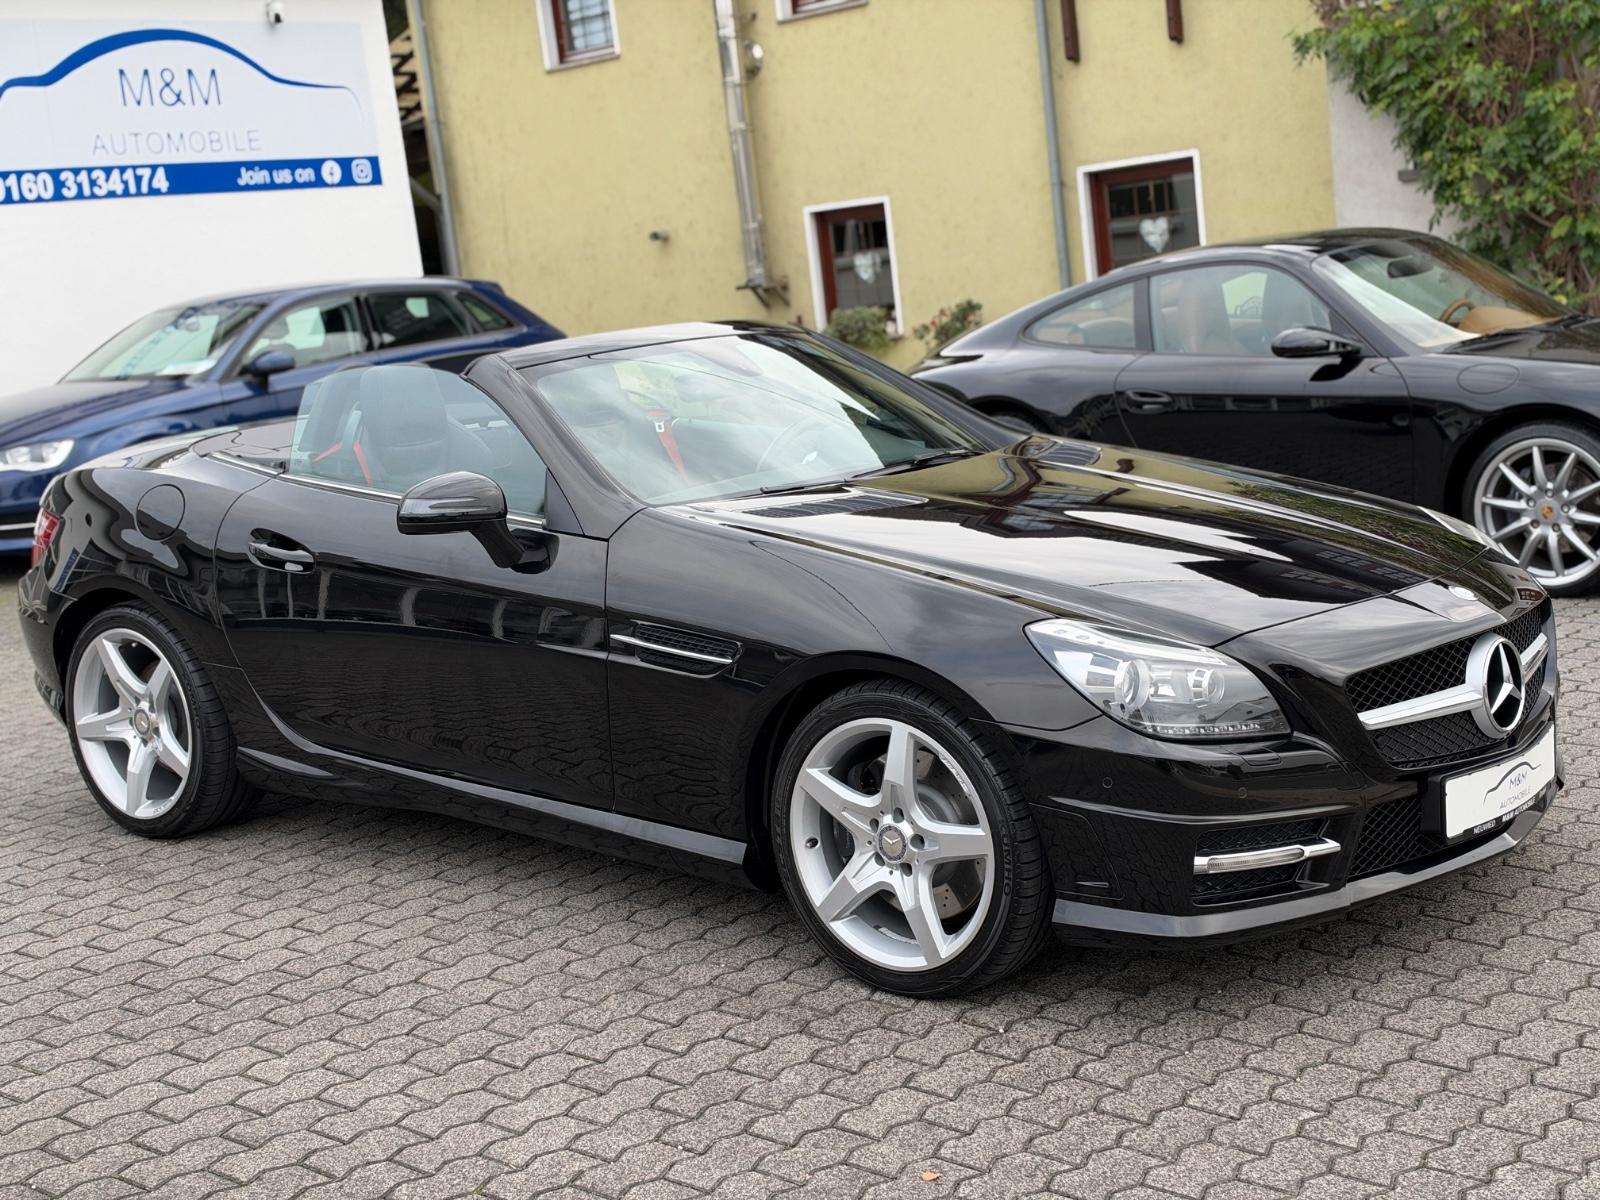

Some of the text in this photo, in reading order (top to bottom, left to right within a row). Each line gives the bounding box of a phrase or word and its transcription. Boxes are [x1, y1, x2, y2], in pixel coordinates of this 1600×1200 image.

[118, 68, 221, 107] M&M
[92, 129, 263, 157] AUTOMOBILE
[59, 166, 170, 198] 3134174
[237, 166, 316, 186] Join us on
[1509, 769, 1528, 790] M&M
